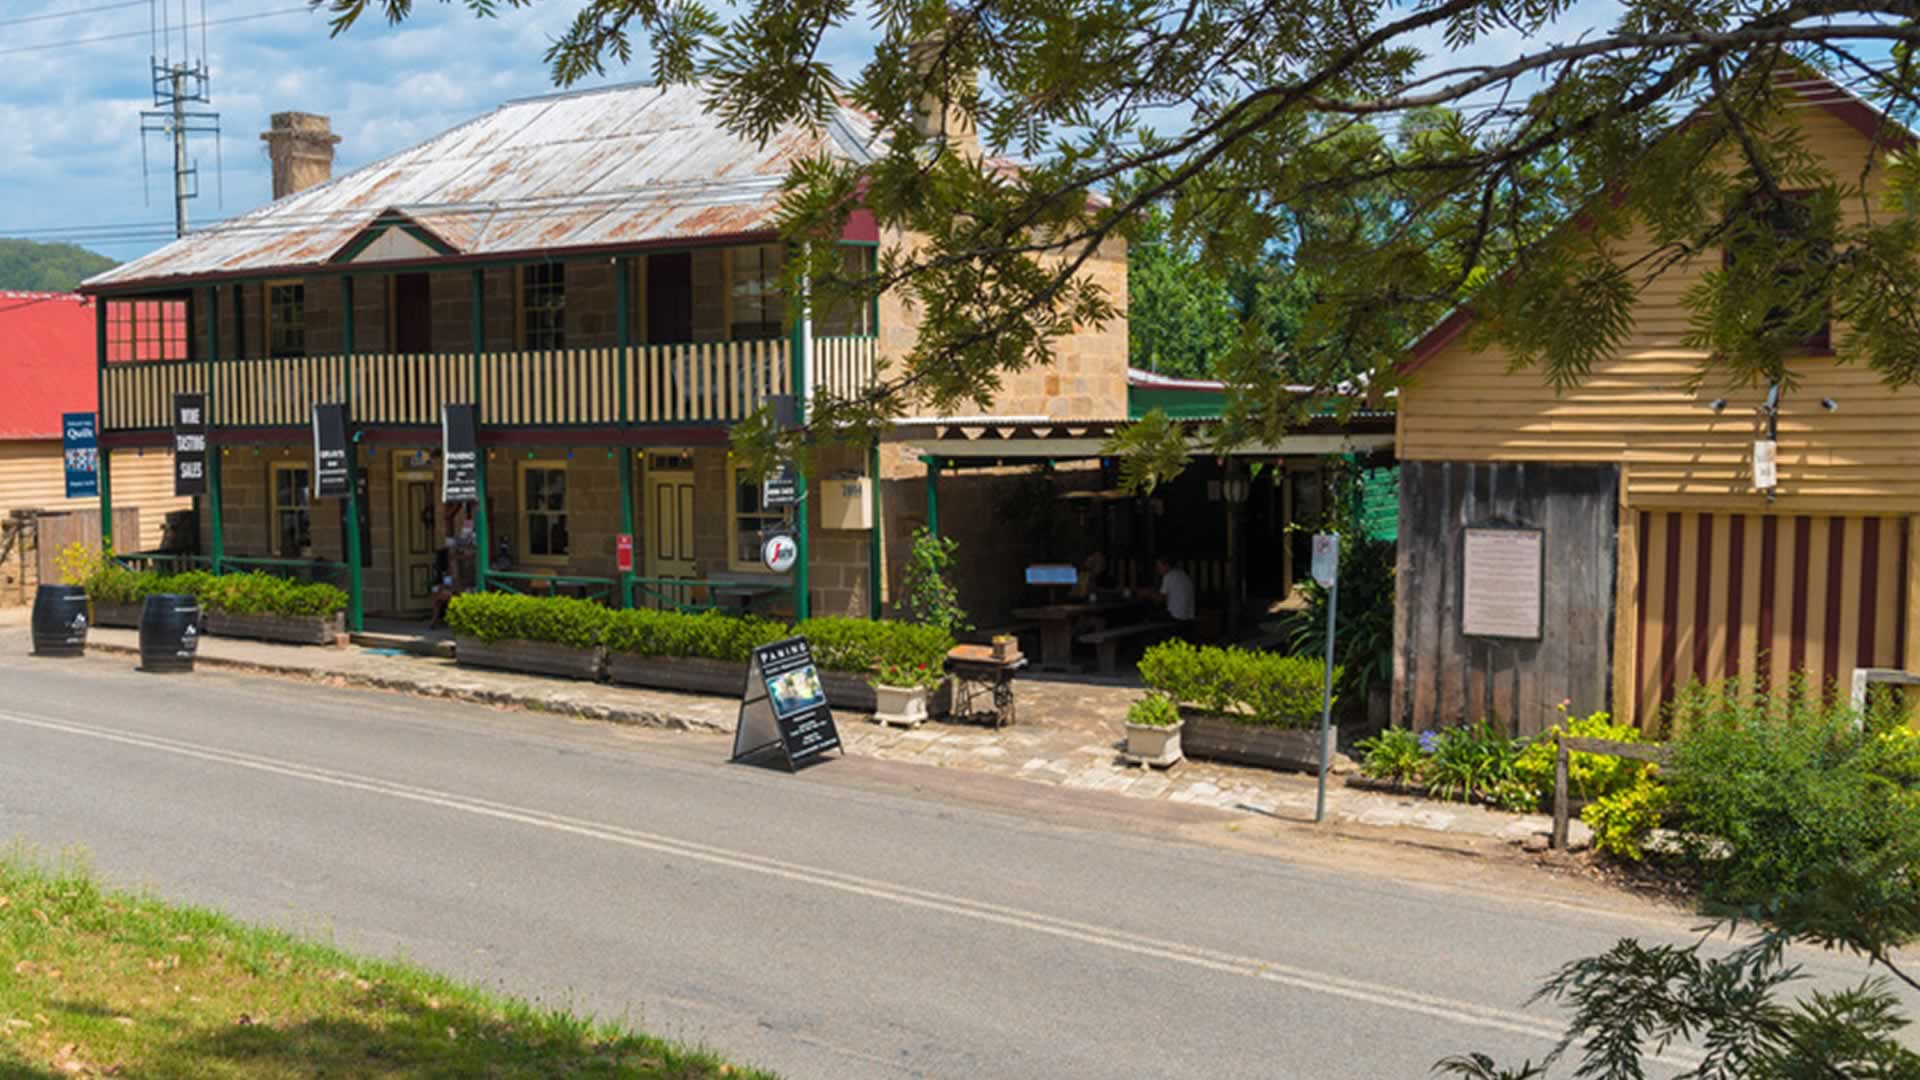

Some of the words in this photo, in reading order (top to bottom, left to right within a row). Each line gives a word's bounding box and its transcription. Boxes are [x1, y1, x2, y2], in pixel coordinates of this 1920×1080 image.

[181, 408, 200, 424] WINE
[176, 435, 206, 451] TASTING
[180, 462, 202, 479] SALES
